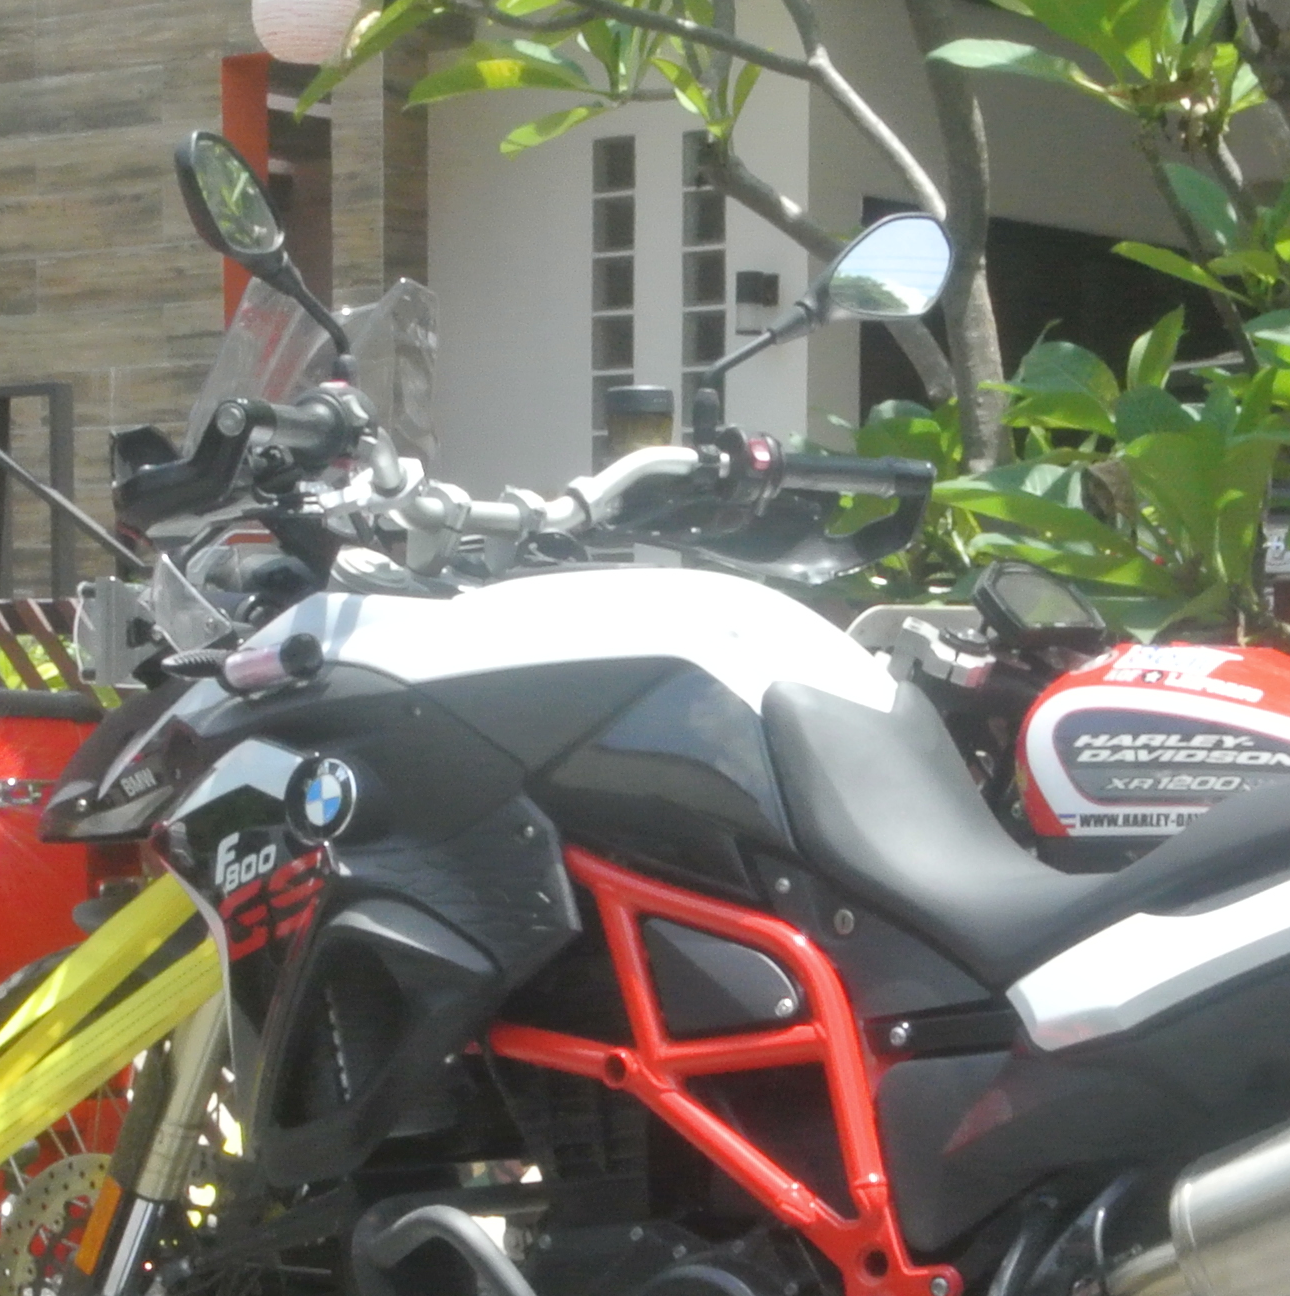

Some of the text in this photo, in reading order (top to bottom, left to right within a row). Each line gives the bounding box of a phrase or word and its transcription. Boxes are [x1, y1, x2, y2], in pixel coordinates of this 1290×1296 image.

[1074, 733, 1255, 749] HARLEY-
[120, 767, 157, 798] BMW
[218, 848, 326, 962] GS
